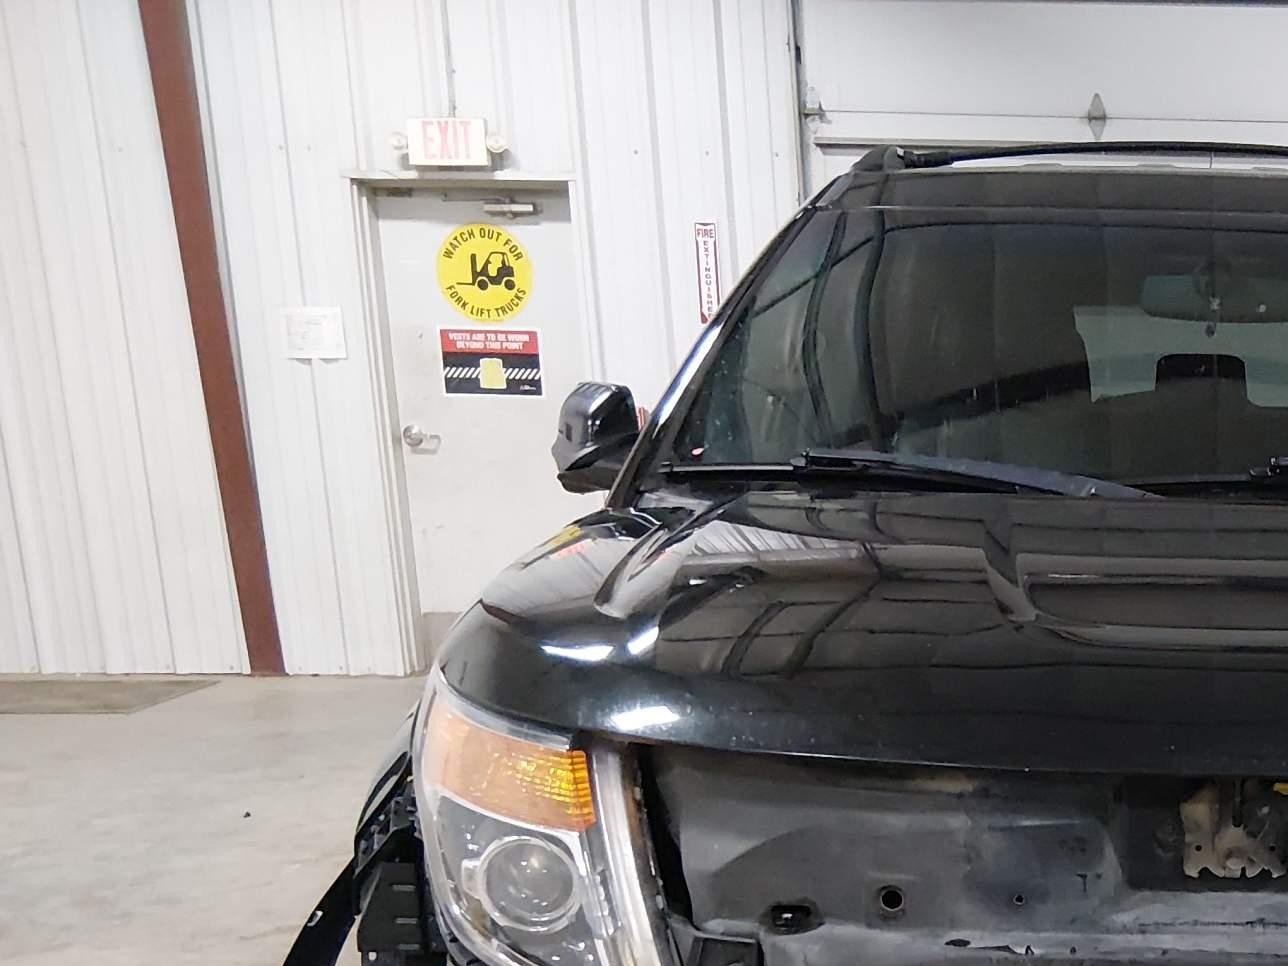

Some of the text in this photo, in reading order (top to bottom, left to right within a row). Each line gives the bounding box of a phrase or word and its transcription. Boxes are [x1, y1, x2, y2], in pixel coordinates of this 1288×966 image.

[421, 120, 471, 159] EXIT
[443, 227, 524, 261] WATCH OUT FOR
[696, 228, 715, 239] FIRE
[445, 284, 527, 319] FORK LIFT TRUCKS
[486, 333, 497, 341] TO
